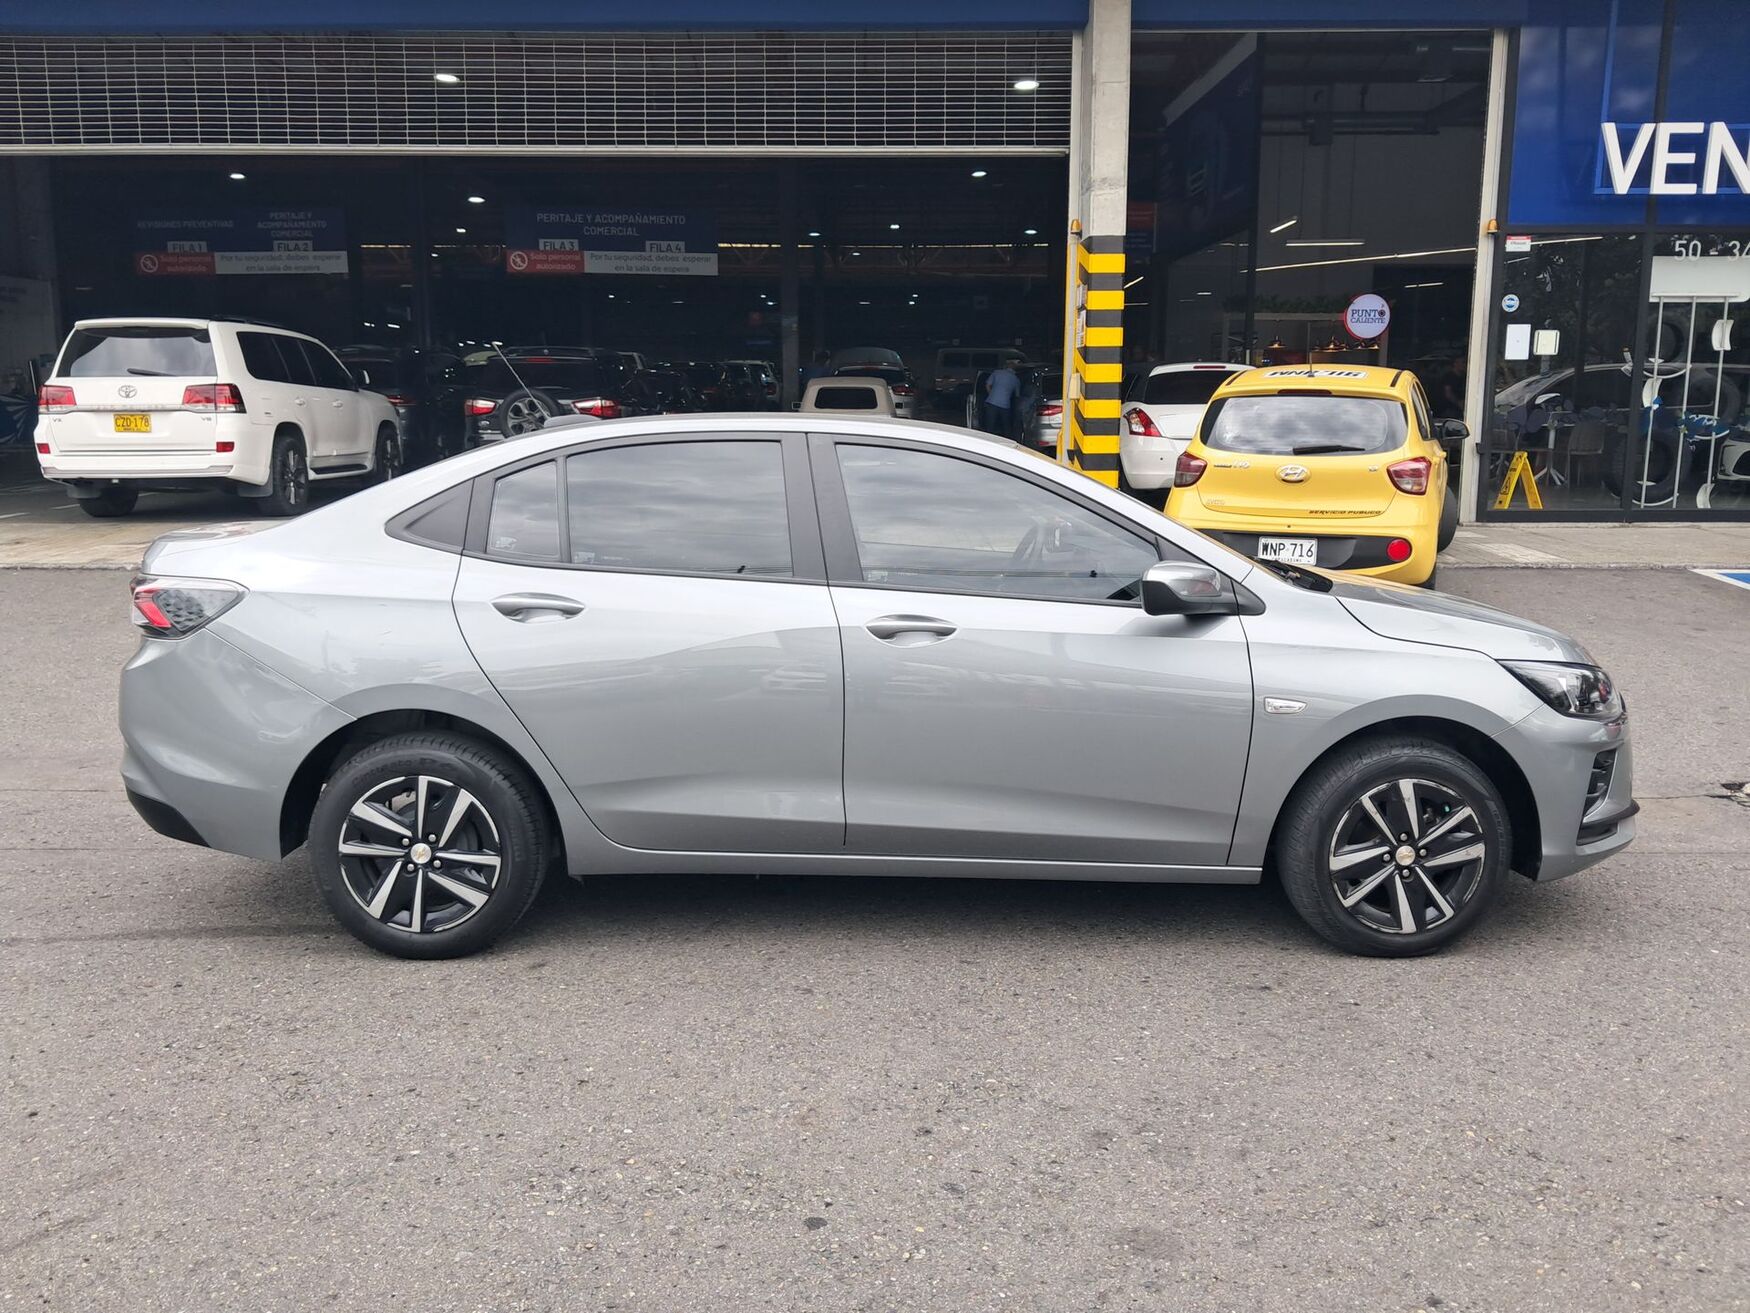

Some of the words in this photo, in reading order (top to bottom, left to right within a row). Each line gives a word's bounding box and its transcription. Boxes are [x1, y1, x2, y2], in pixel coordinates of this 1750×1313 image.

[1601, 122, 1750, 195] VEN
[270, 212, 303, 220] PERITAJE
[537, 213, 585, 224] PERITAJE
[586, 214, 592, 224] Y
[595, 212, 686, 224] ACOMPAÑAMIENTO
[583, 226, 640, 236] COMERCIAL
[173, 243, 196, 252] FILA
[277, 243, 299, 252] FILA
[301, 243, 309, 252] 2
[543, 241, 565, 250] FILA
[568, 241, 575, 250] 3
[650, 243, 672, 252] FILA
[674, 243, 681, 252] 4
[1674, 240, 1701, 262] 50
[548, 253, 581, 262] personal
[656, 254, 679, 262] debes
[683, 256, 711, 264] esperar
[626, 264, 632, 272] la
[634, 264, 649, 272] sala
[652, 264, 661, 272] de
[663, 265, 689, 273] espera
[1351, 308, 1386, 318] PUNTO
[1262, 543, 1286, 555] WNP
[1290, 544, 1314, 557] 716
